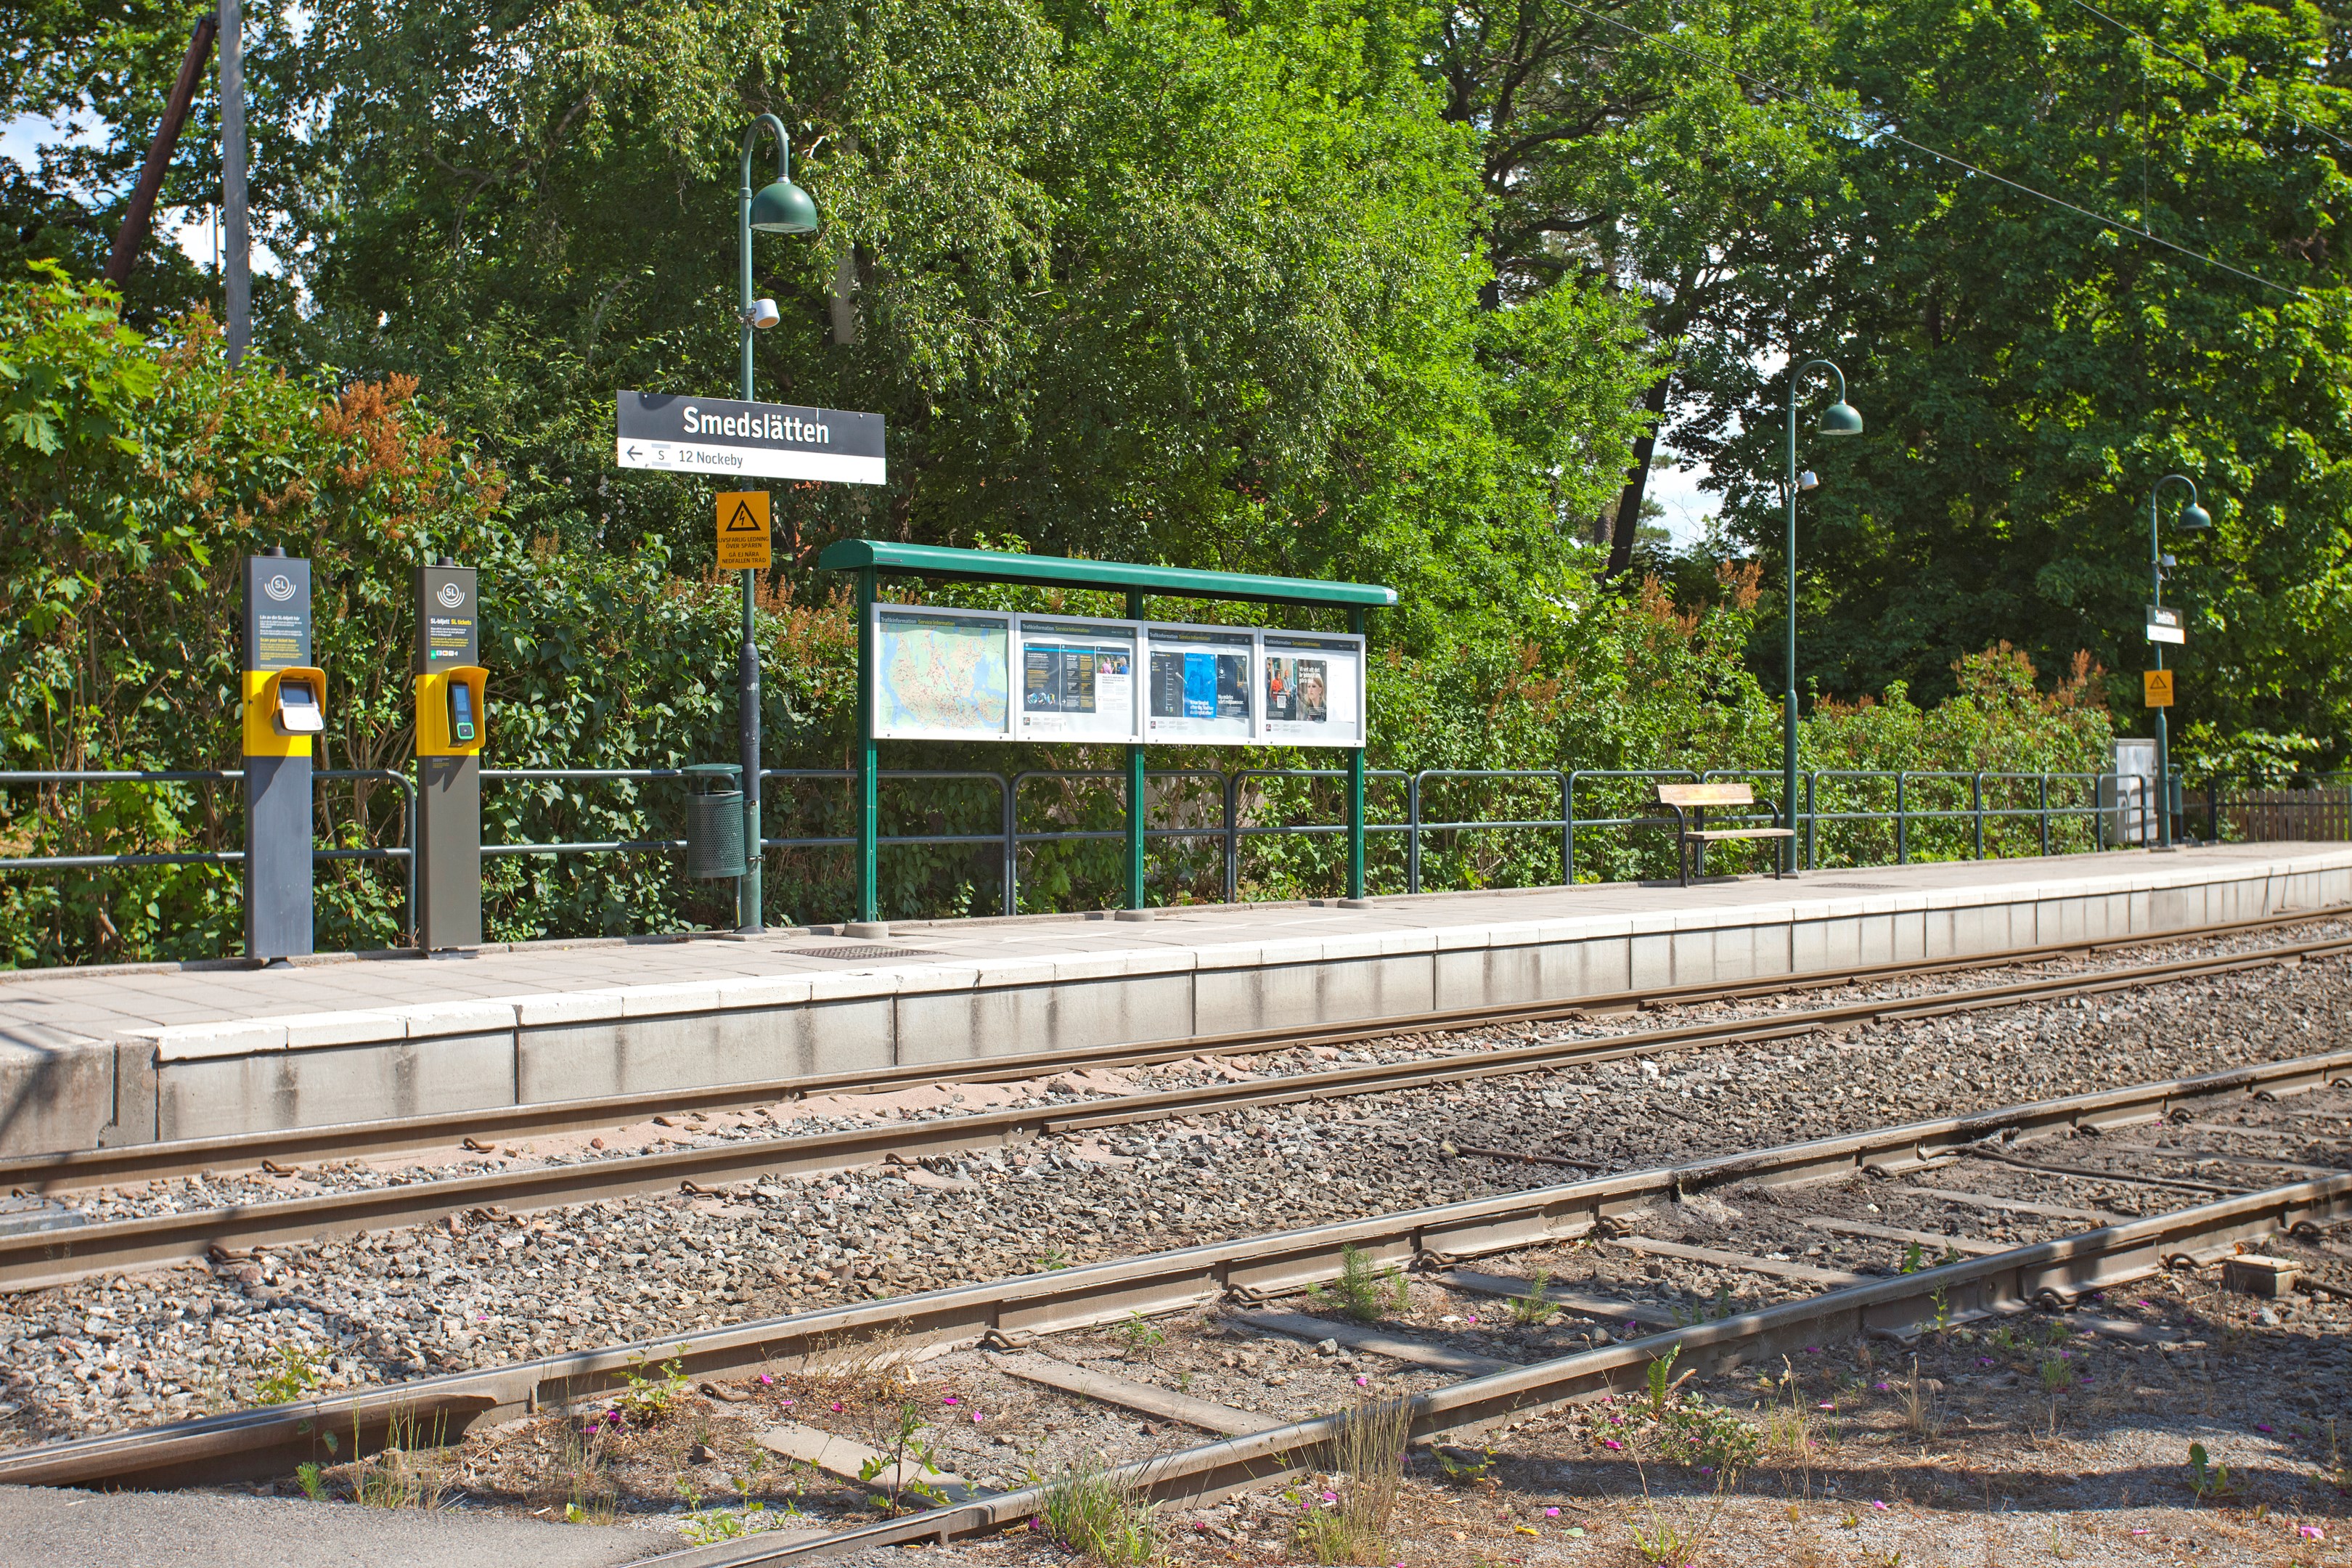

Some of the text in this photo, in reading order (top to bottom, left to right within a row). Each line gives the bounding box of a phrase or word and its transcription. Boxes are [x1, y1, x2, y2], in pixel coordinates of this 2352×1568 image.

[682, 406, 830, 444] Smedslätten
[658, 450, 743, 468] S 12 Nockeby
[274, 580, 286, 589] SL
[446, 587, 456, 597] SL
